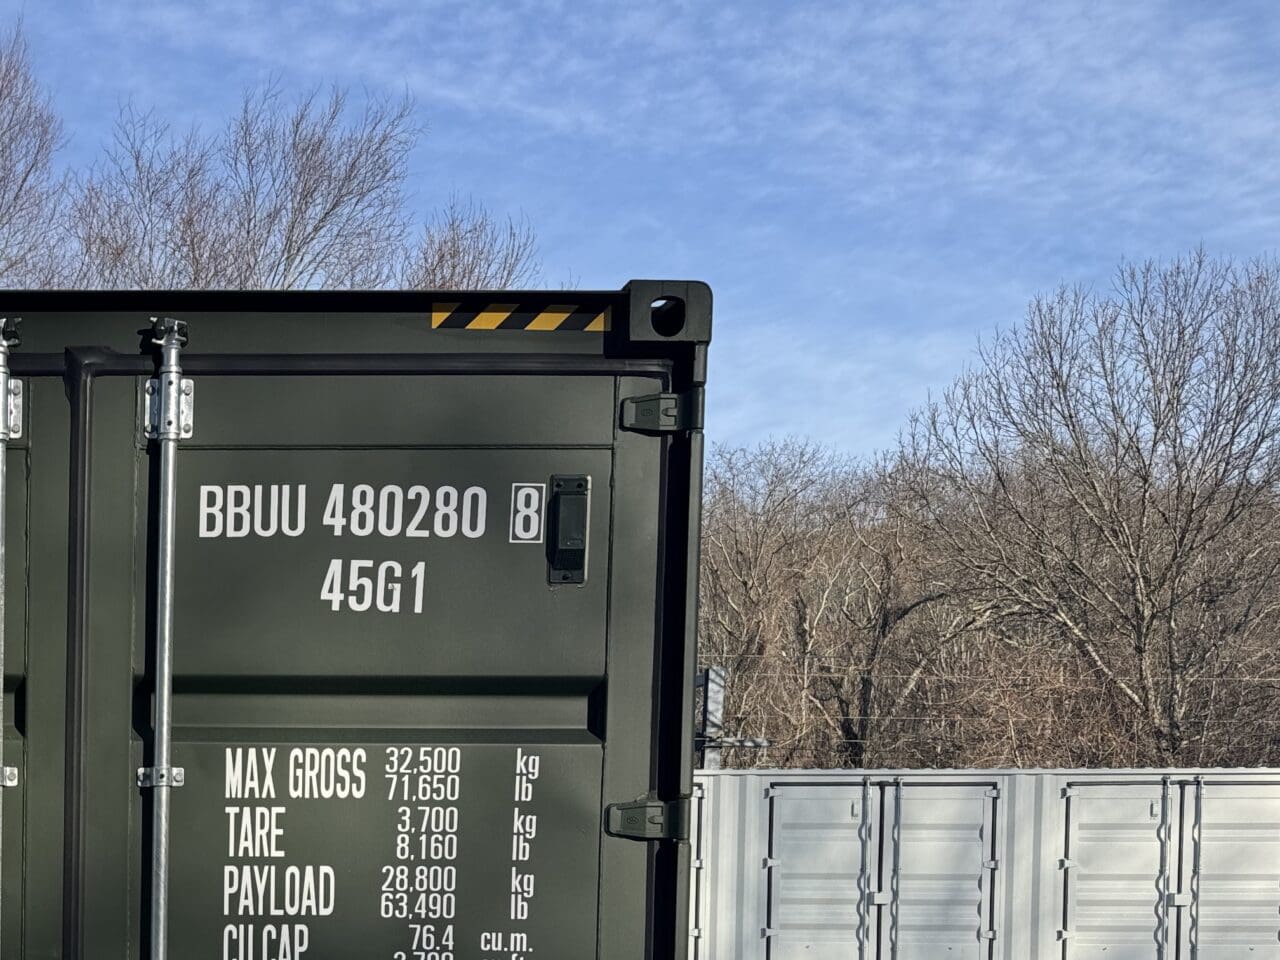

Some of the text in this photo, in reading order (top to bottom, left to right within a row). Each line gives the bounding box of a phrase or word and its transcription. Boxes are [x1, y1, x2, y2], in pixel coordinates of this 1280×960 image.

[198, 483, 543, 541] BBUU 480280 8
[320, 559, 426, 614] 45G1
[225, 747, 540, 799] MAX GROSS 32,500 kg
[385, 774, 533, 801] 71,650 lb
[225, 806, 537, 857] TARE 3,700 kg
[396, 834, 530, 861] 8,160 lb
[223, 865, 535, 916] PAYLOAD 28,800 kg
[380, 892, 528, 920] 63,490 lb
[408, 924, 455, 951] 76.4
[480, 931, 533, 952] cu.m.
